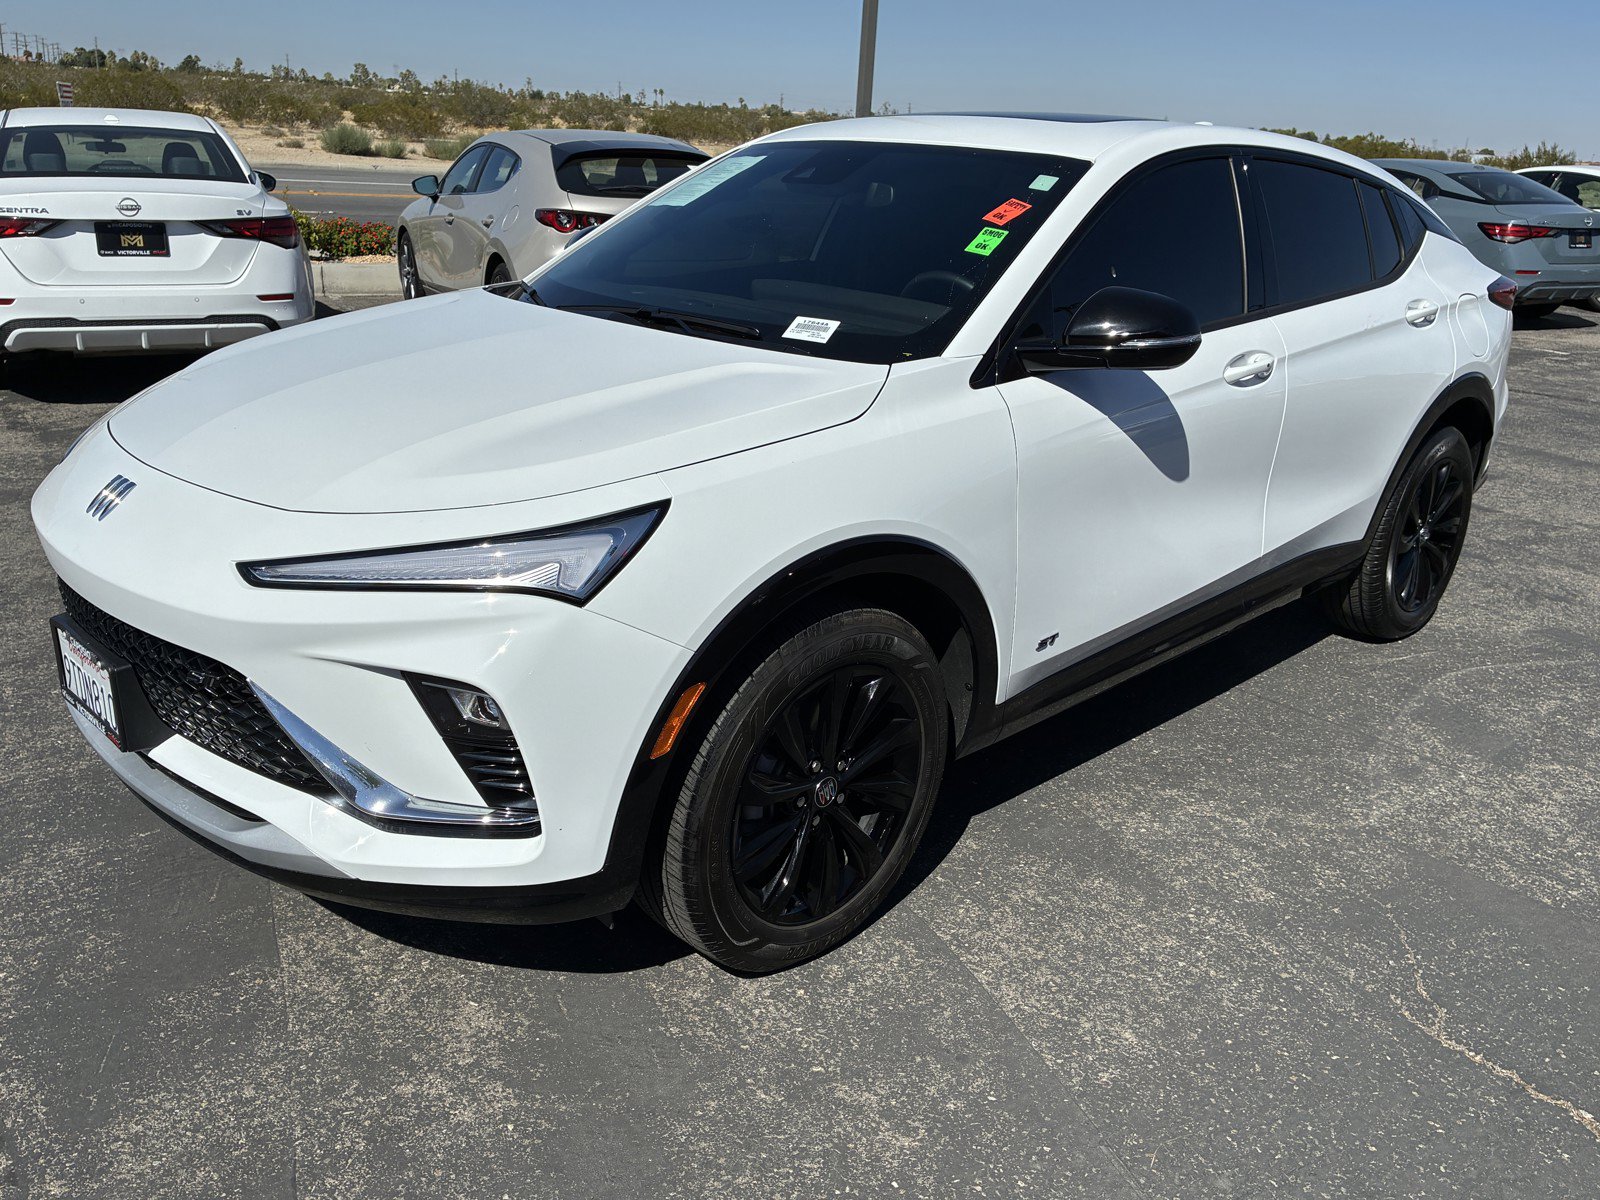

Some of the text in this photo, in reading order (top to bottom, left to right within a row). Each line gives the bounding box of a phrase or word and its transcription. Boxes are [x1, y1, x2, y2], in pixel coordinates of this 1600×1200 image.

[0, 207, 49, 215] SENTRA
[115, 204, 142, 212] NISSAN
[992, 212, 1007, 220] OK
[982, 229, 1005, 239] SMOG
[974, 243, 990, 251] OK
